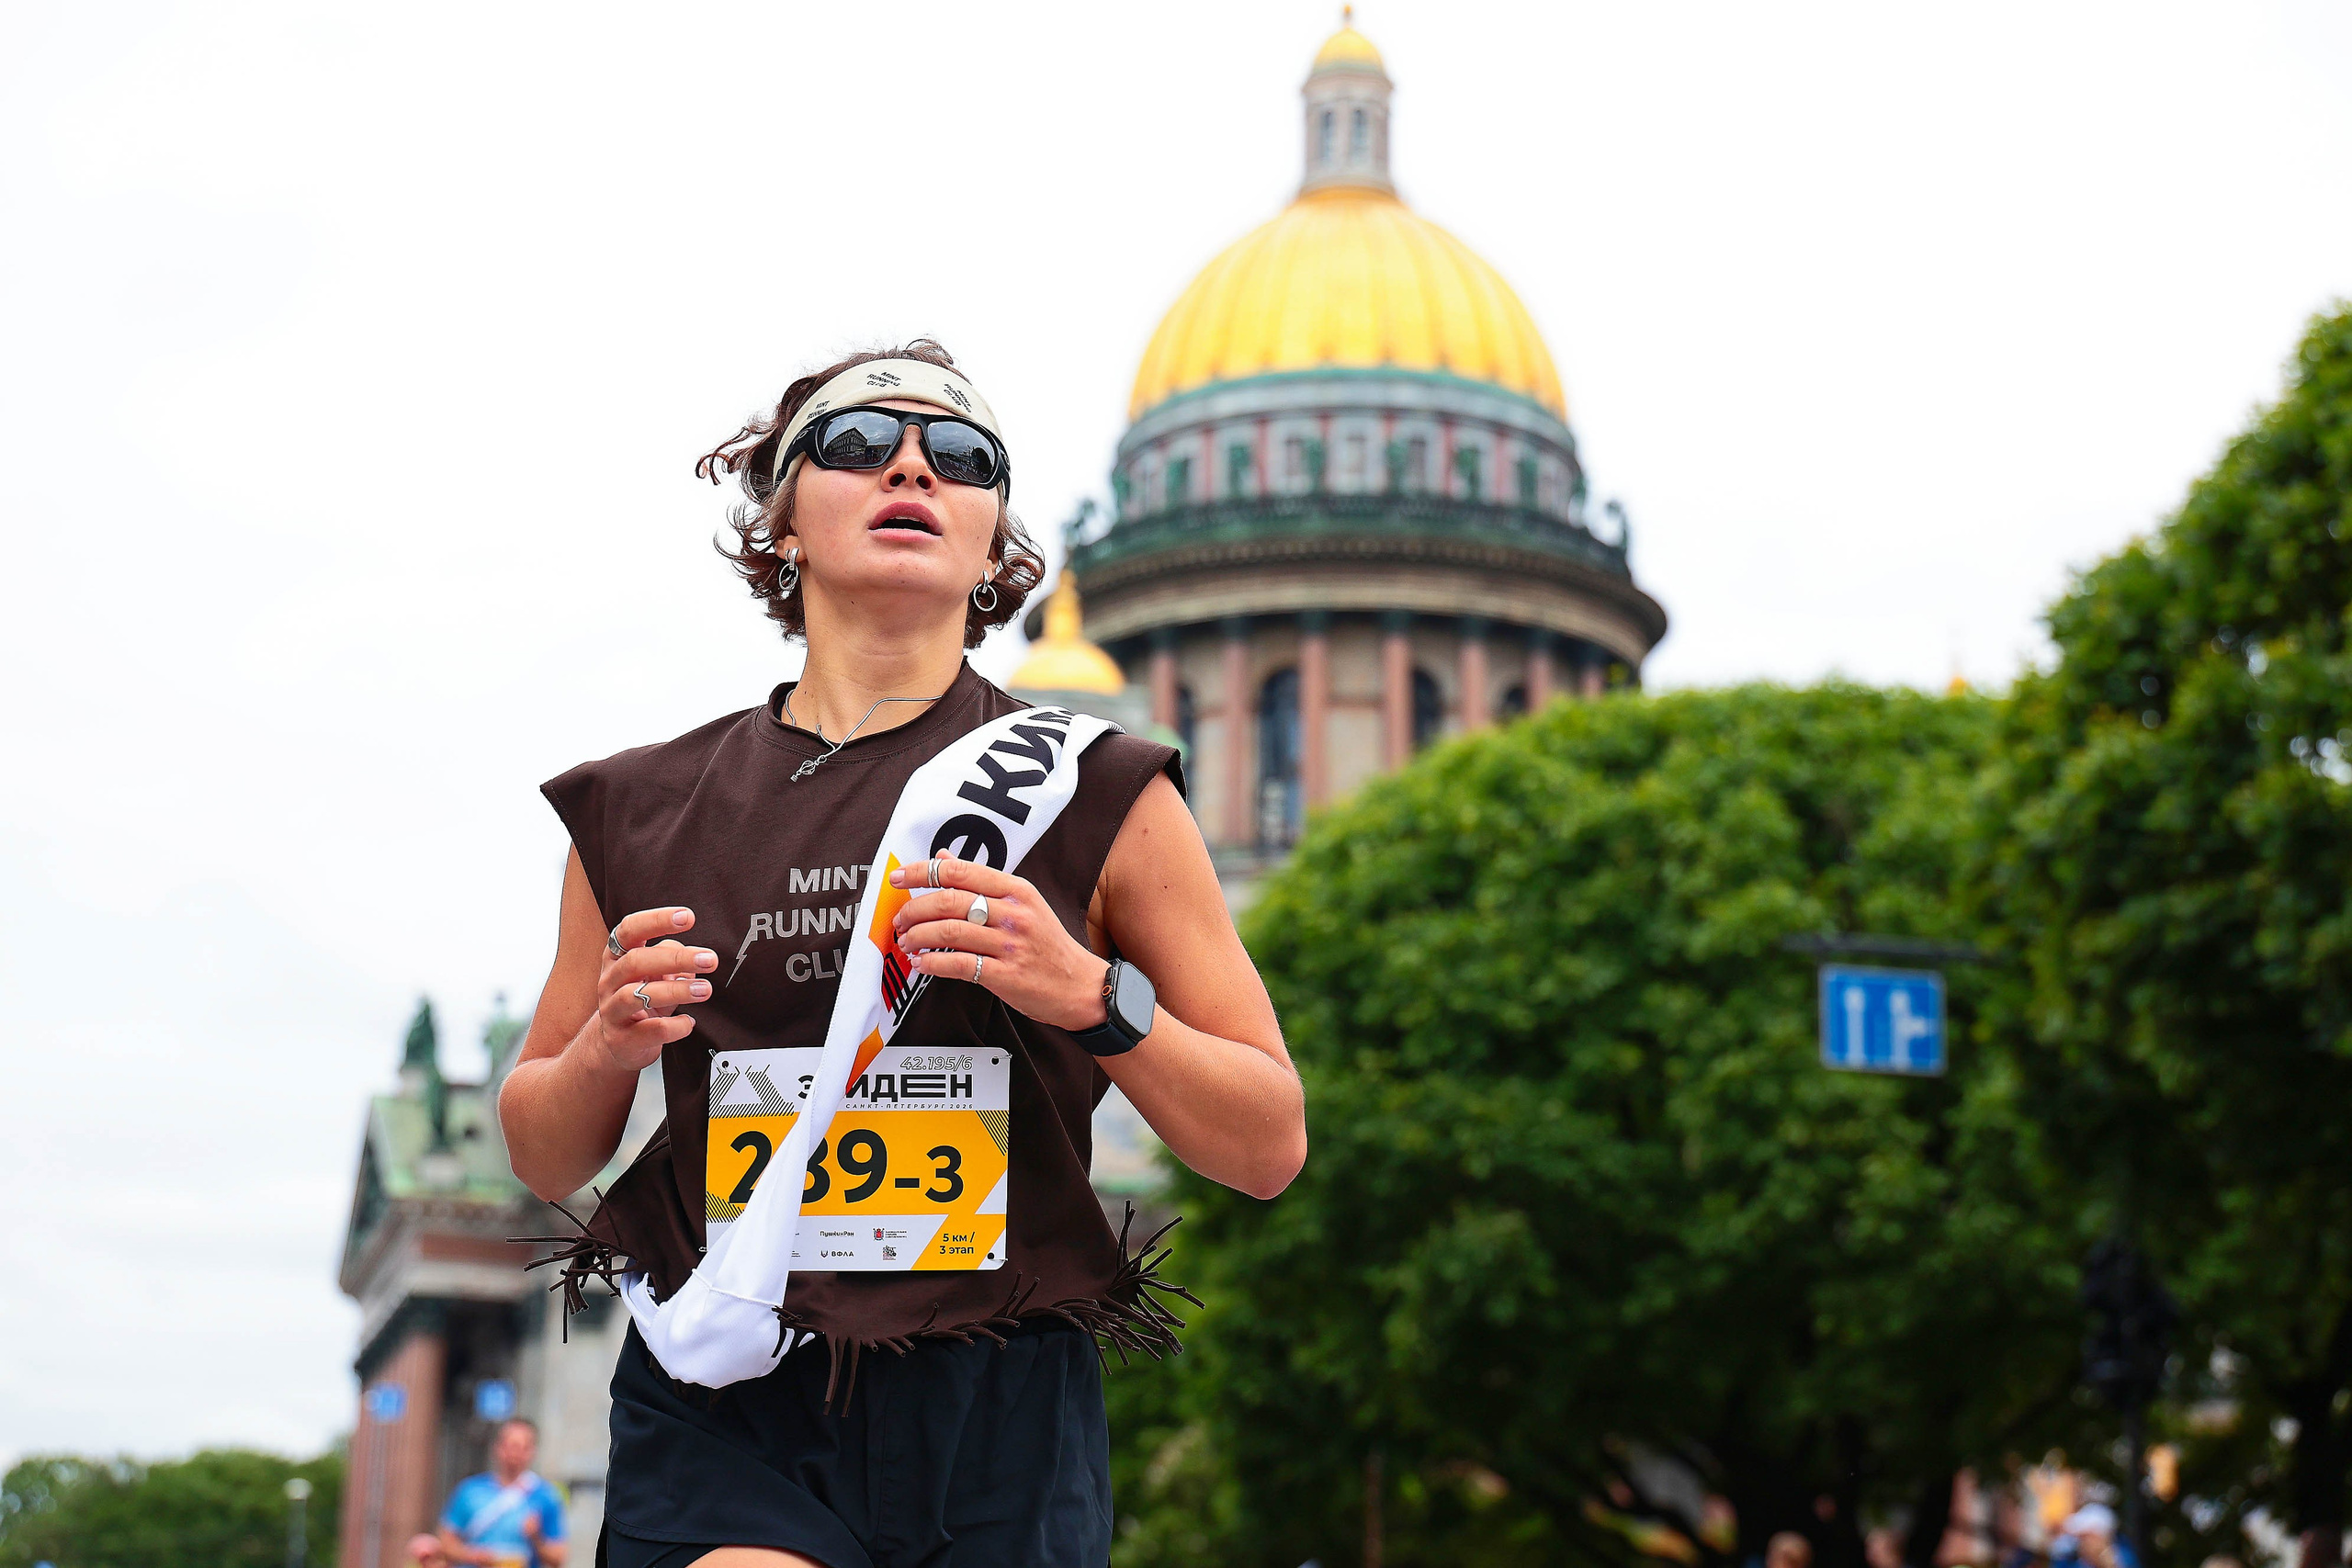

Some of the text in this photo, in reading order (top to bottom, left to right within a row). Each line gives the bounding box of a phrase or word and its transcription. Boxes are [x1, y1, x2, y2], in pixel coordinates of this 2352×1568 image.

[899, 1054, 974, 1071] 42.195/6
[797, 1074, 973, 1102] ЭИДЕН
[943, 1231, 976, 1244] 5 км /
[939, 1245, 974, 1255] 3 этап
